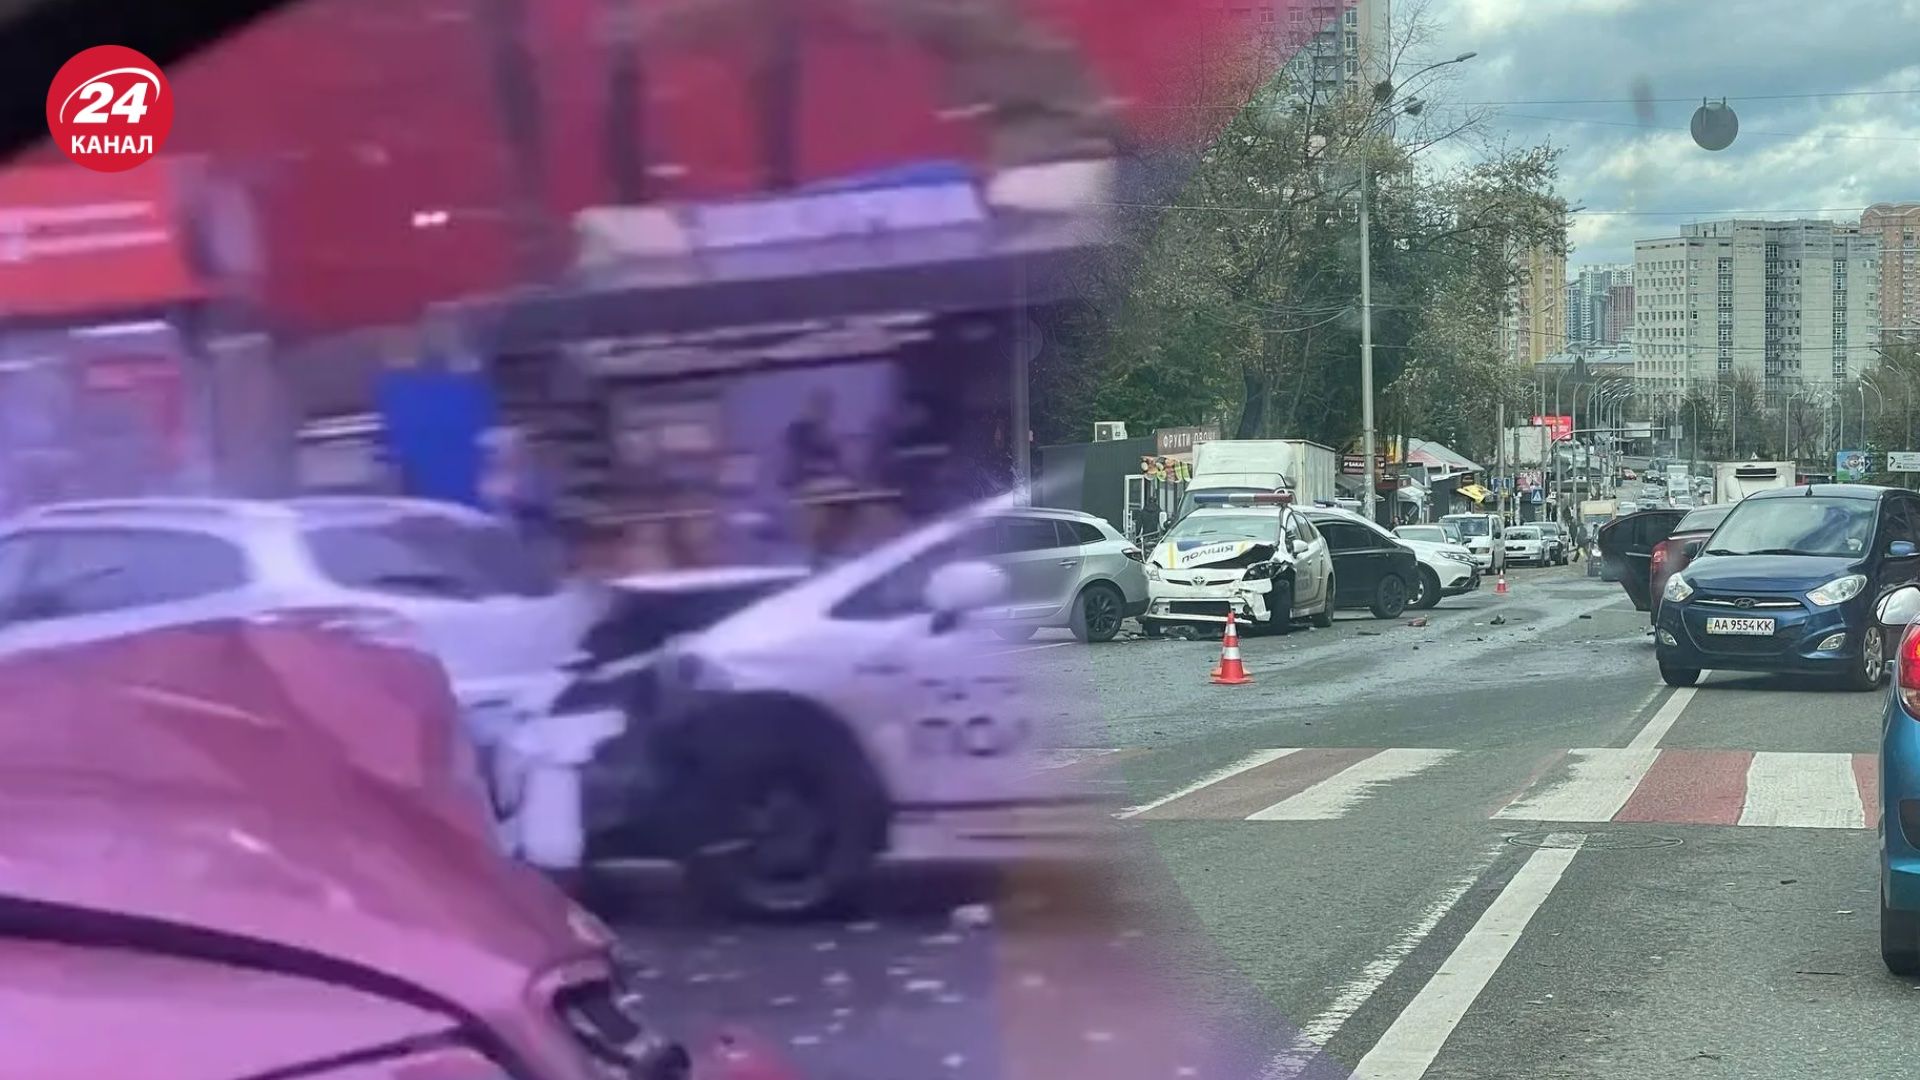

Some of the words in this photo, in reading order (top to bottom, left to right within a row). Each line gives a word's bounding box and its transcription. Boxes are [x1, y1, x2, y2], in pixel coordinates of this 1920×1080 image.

[1163, 433, 1191, 448] ФРУКТИ
[1181, 544, 1234, 563] ПОЛІЦІЯ
[1714, 619, 1729, 630] AA
[1730, 619, 1755, 631] 9554
[1757, 620, 1772, 631] KK
